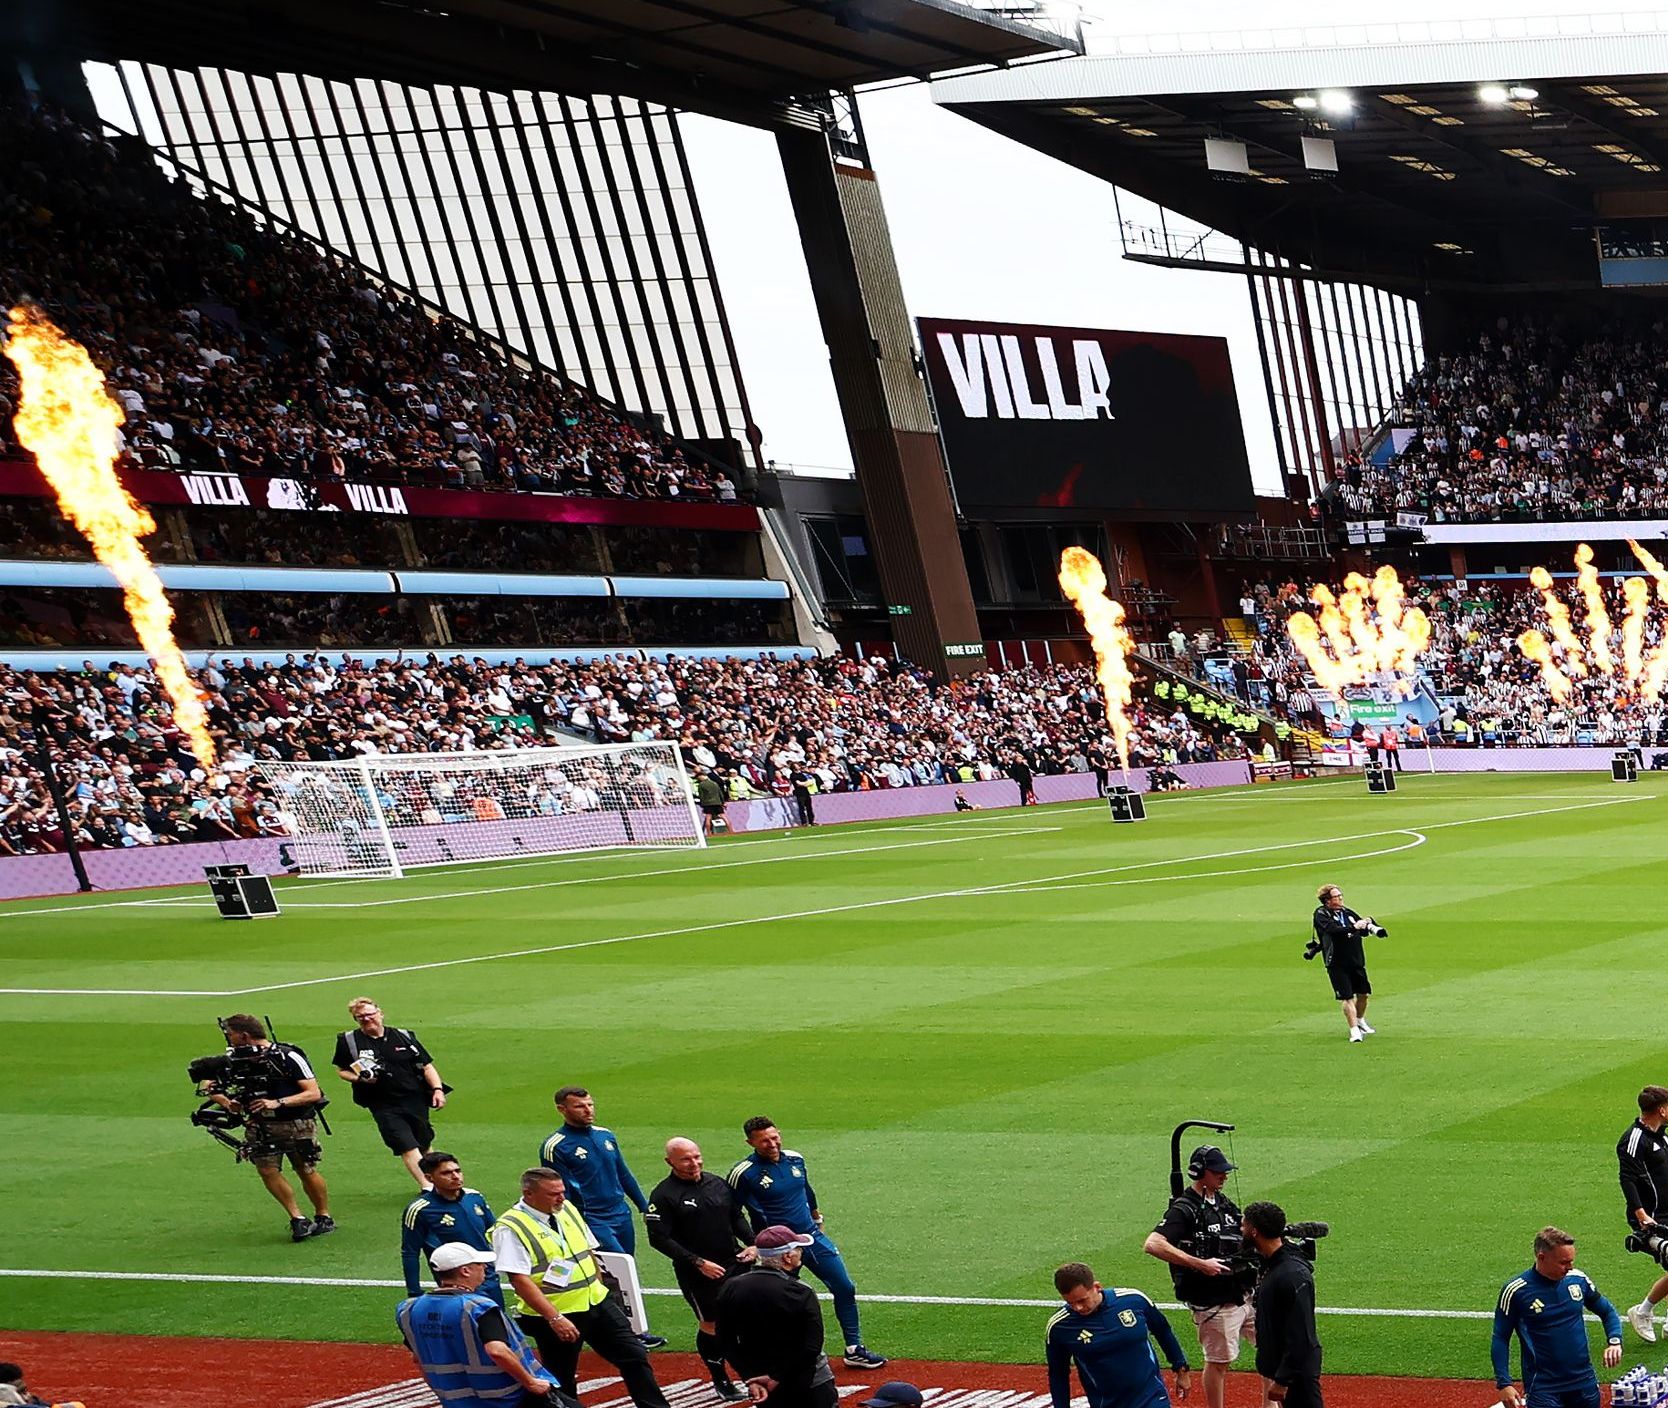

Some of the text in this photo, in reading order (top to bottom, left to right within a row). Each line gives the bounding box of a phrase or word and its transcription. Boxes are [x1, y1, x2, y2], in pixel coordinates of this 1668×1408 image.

[936, 332, 1115, 420] VILLA
[180, 475, 250, 505] VILLA
[344, 483, 408, 514] VILLA
[945, 644, 984, 655] FIRE EXIT
[1350, 703, 1395, 713] Fire exit
